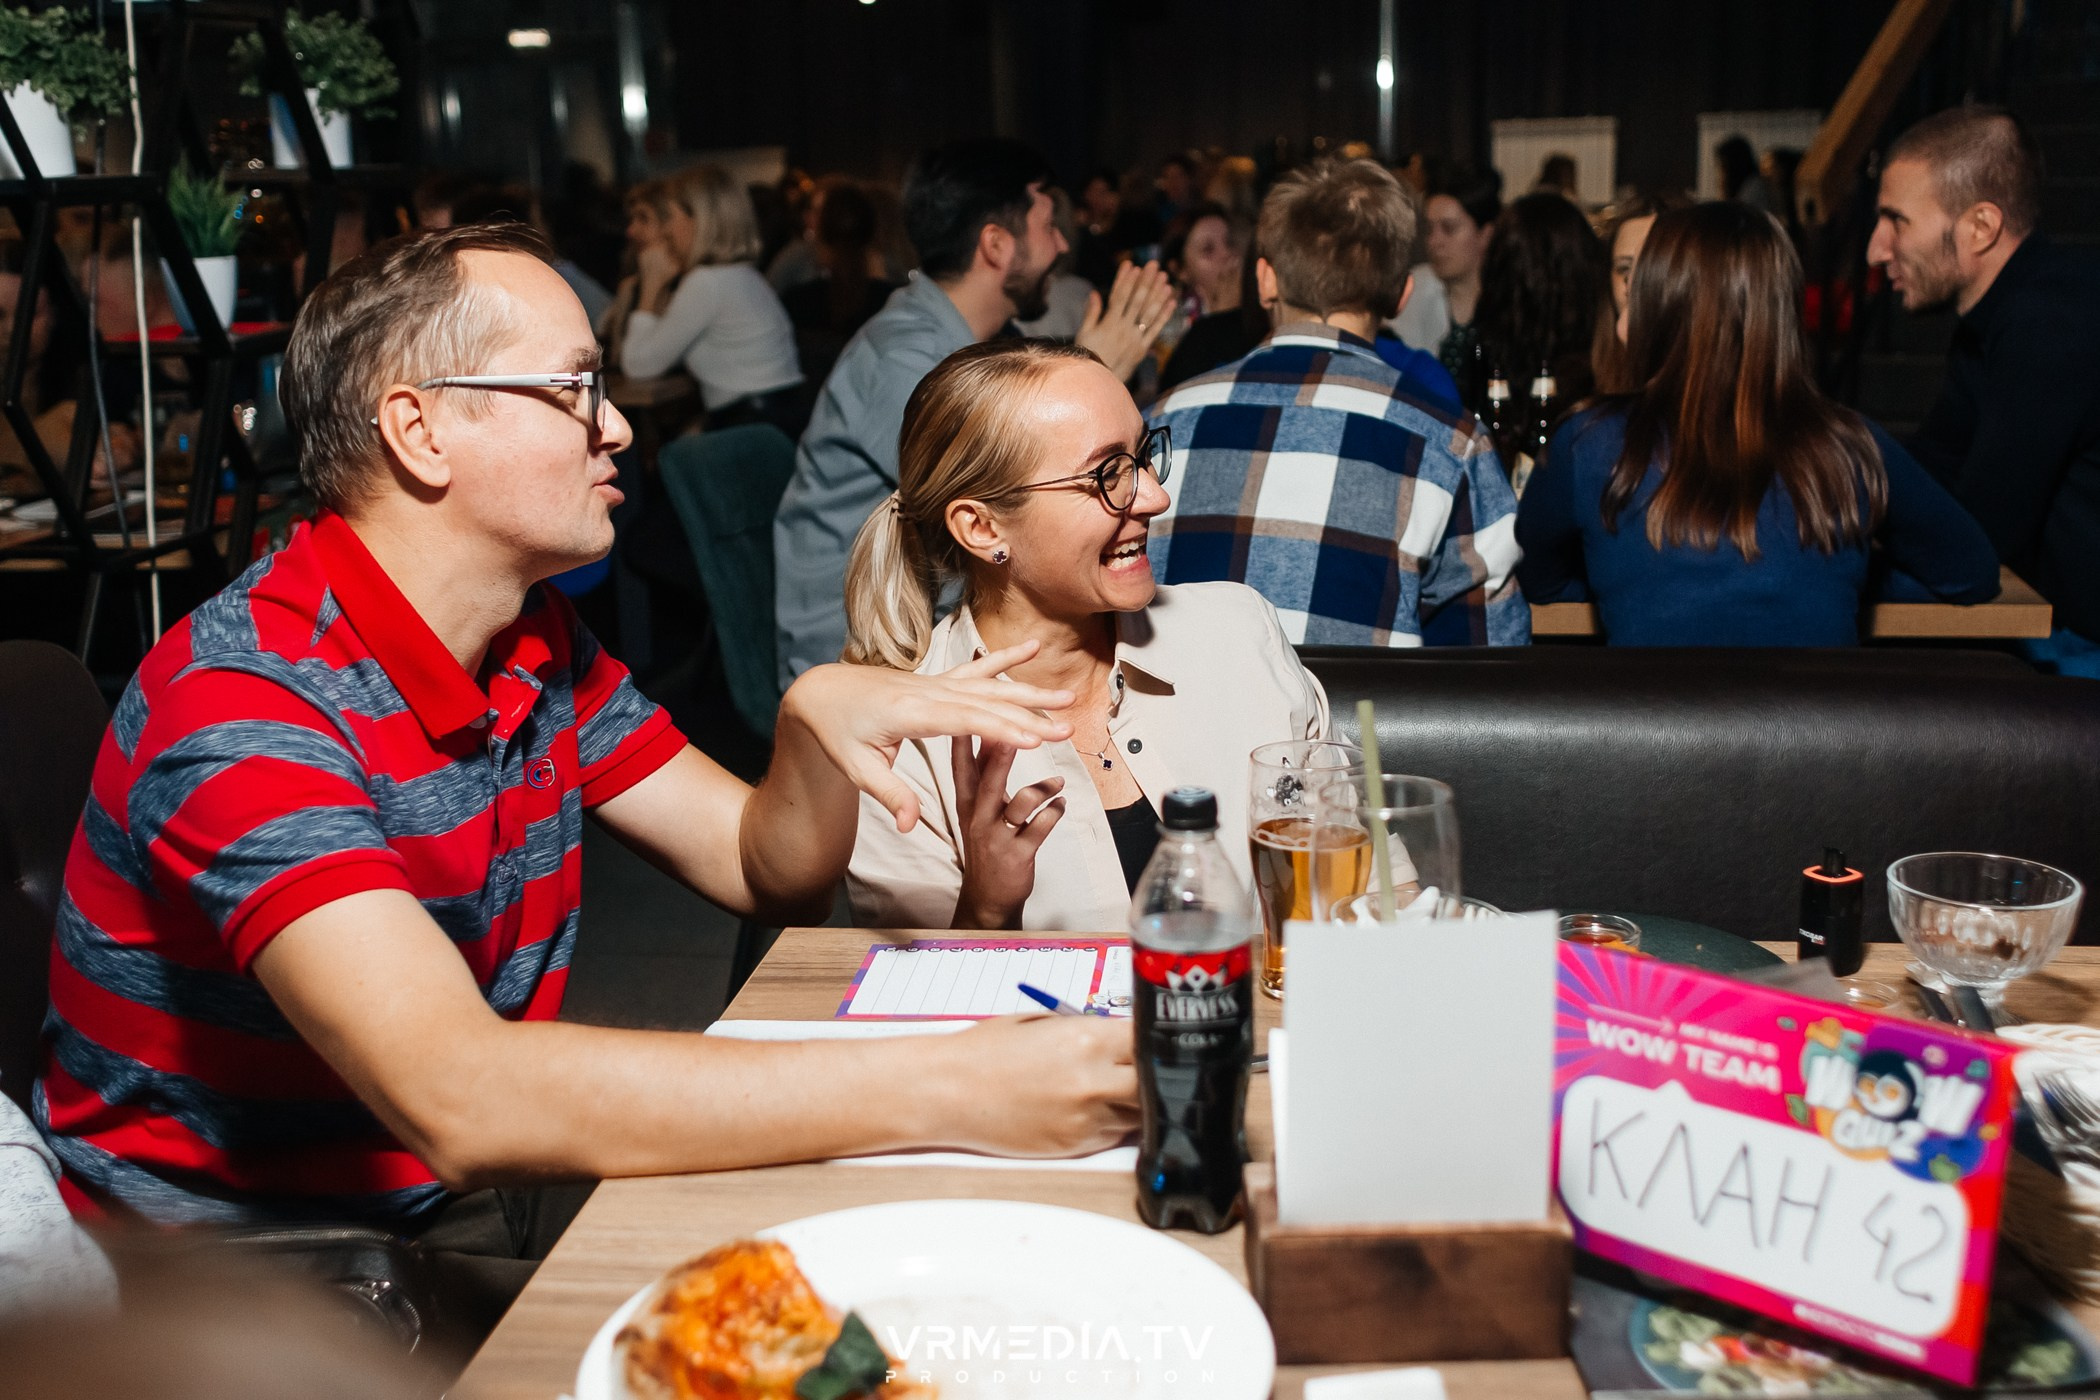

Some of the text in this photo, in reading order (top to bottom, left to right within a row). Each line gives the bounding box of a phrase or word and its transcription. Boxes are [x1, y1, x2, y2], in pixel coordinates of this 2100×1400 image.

[1586, 1017, 1781, 1094] WOW TEAM
[1832, 1108, 1928, 1162] QUIZ
[1588, 1098, 1947, 1303] КЛАН 42
